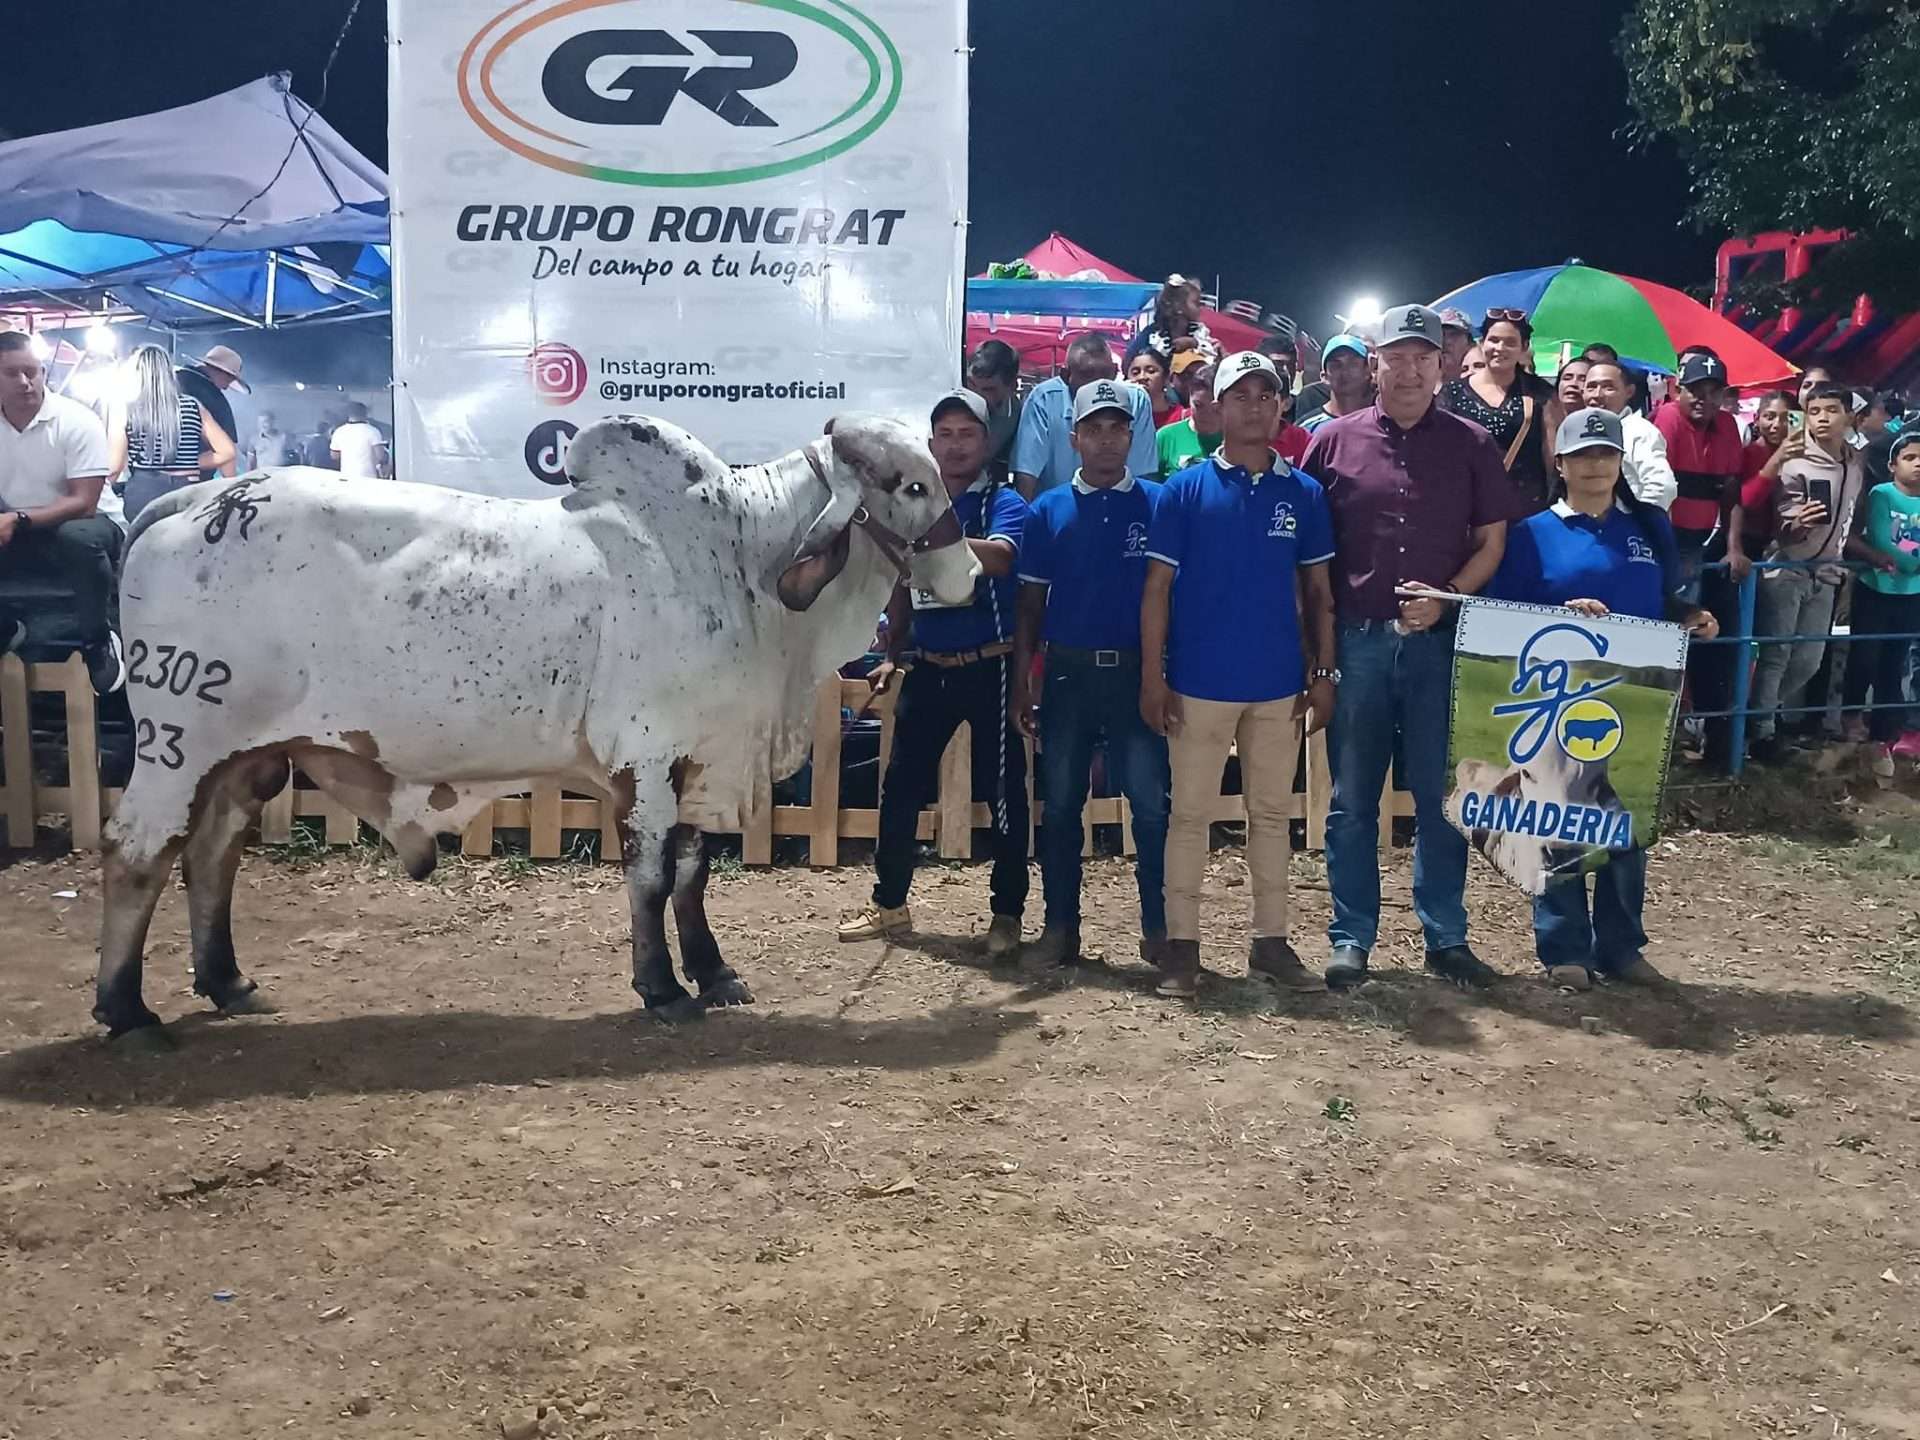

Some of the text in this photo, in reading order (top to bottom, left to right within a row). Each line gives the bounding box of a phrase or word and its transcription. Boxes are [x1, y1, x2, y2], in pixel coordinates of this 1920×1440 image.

[542, 29, 798, 127] GR
[457, 204, 906, 245] GRUPO RONGRAT
[532, 246, 834, 287] Del campo a tu hogar
[600, 357, 716, 379] Instagram:
[600, 380, 846, 402] @gruporongratoficial
[128, 638, 232, 705] 2302
[137, 717, 185, 770] 23
[1460, 790, 1633, 849] GANADERIA
